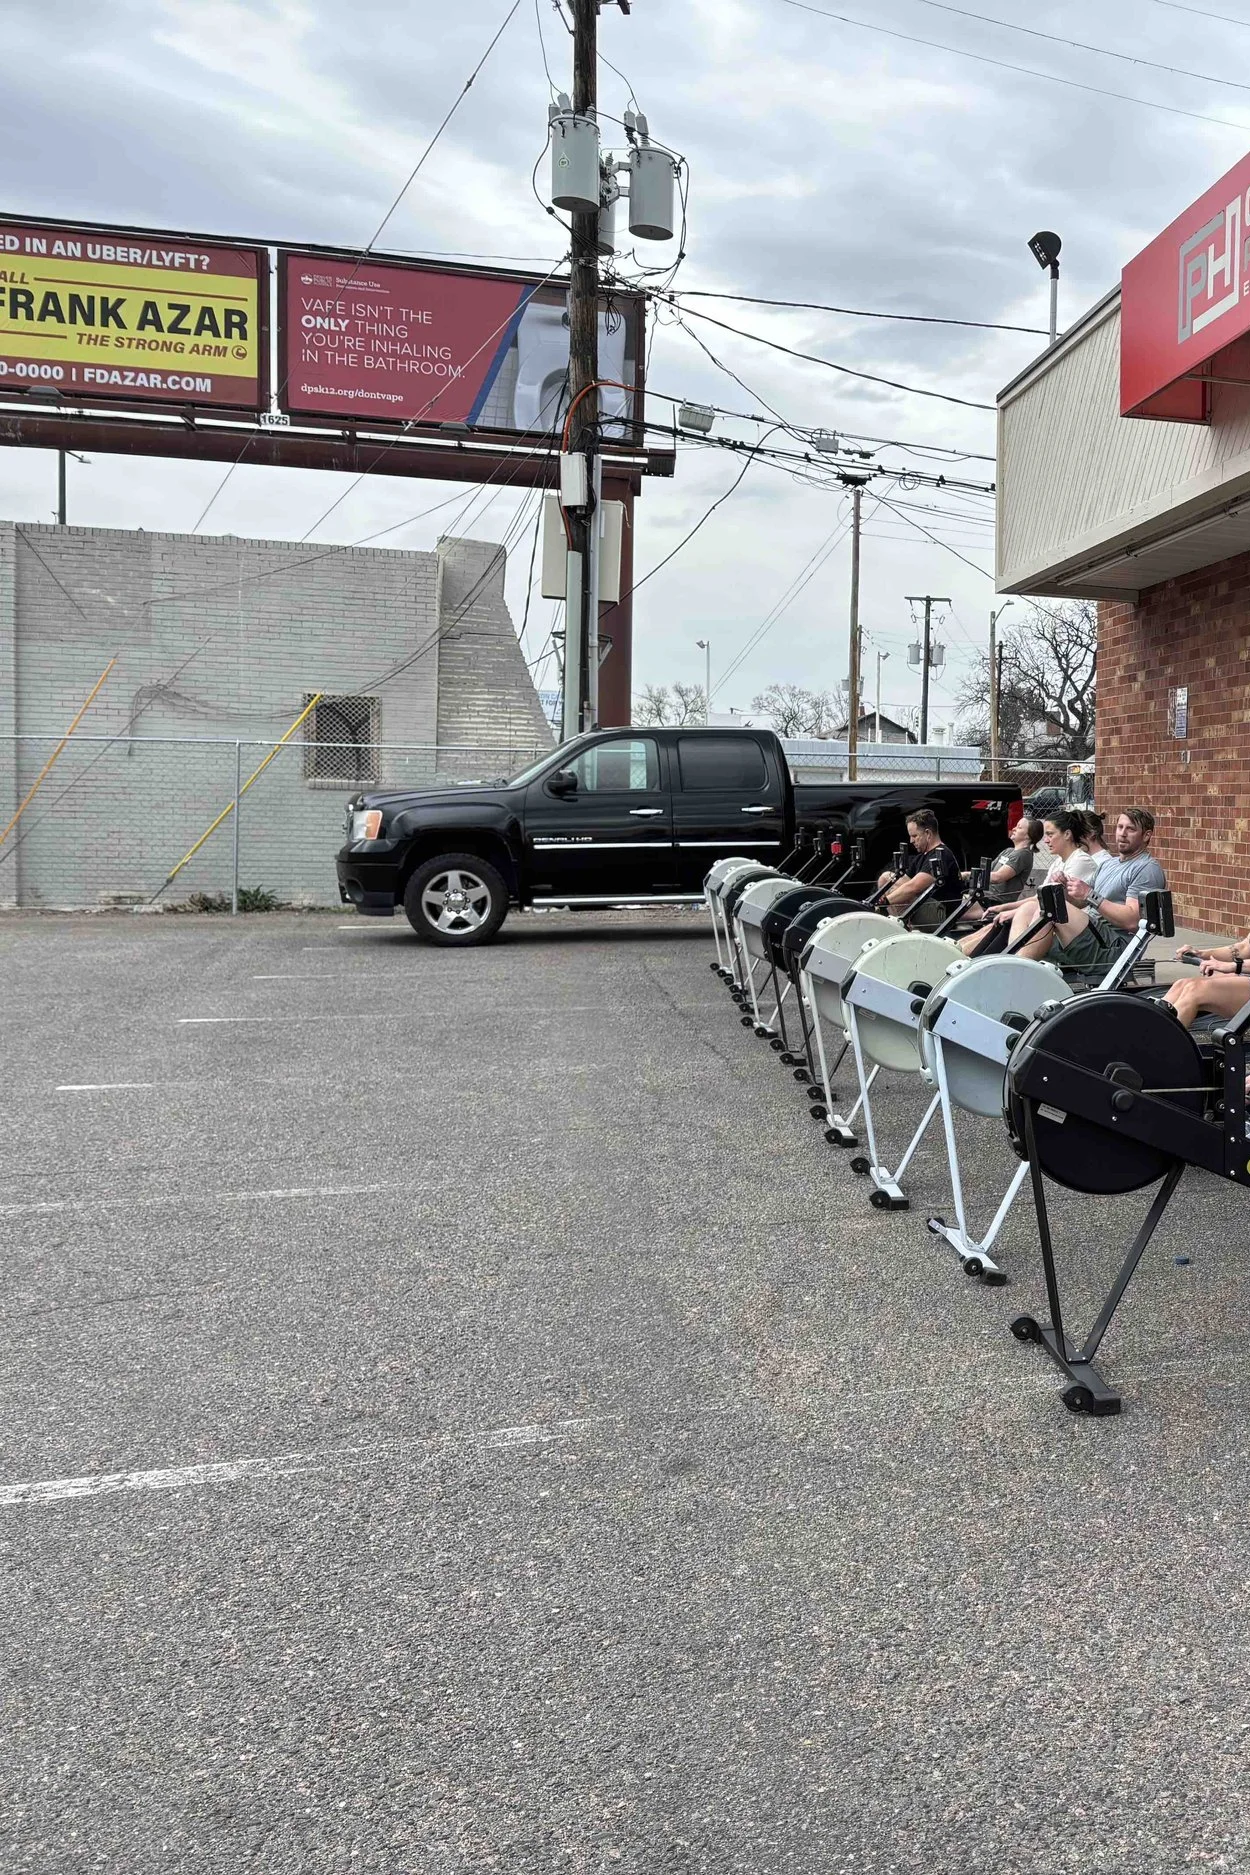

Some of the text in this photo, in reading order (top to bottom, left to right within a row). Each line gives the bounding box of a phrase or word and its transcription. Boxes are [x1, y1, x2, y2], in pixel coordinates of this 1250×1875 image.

[25, 236, 47, 254] IN
[52, 240, 82, 258] AN
[87, 243, 211, 271] UBER/LYFT?
[0, 286, 249, 341] RANK AZAR
[351, 303, 394, 320] ISN'T
[399, 308, 433, 325] THE
[301, 314, 409, 339] ONLY THING
[76, 332, 228, 358] THE STRONG ARM
[301, 331, 452, 360] YOU'RE INHALING
[302, 349, 466, 379] IN THE BATHROOM.
[84, 368, 212, 393] FDAZAR.COM
[301, 383, 404, 403] dpsk12.org/dontvape
[261, 413, 288, 426] 1625
